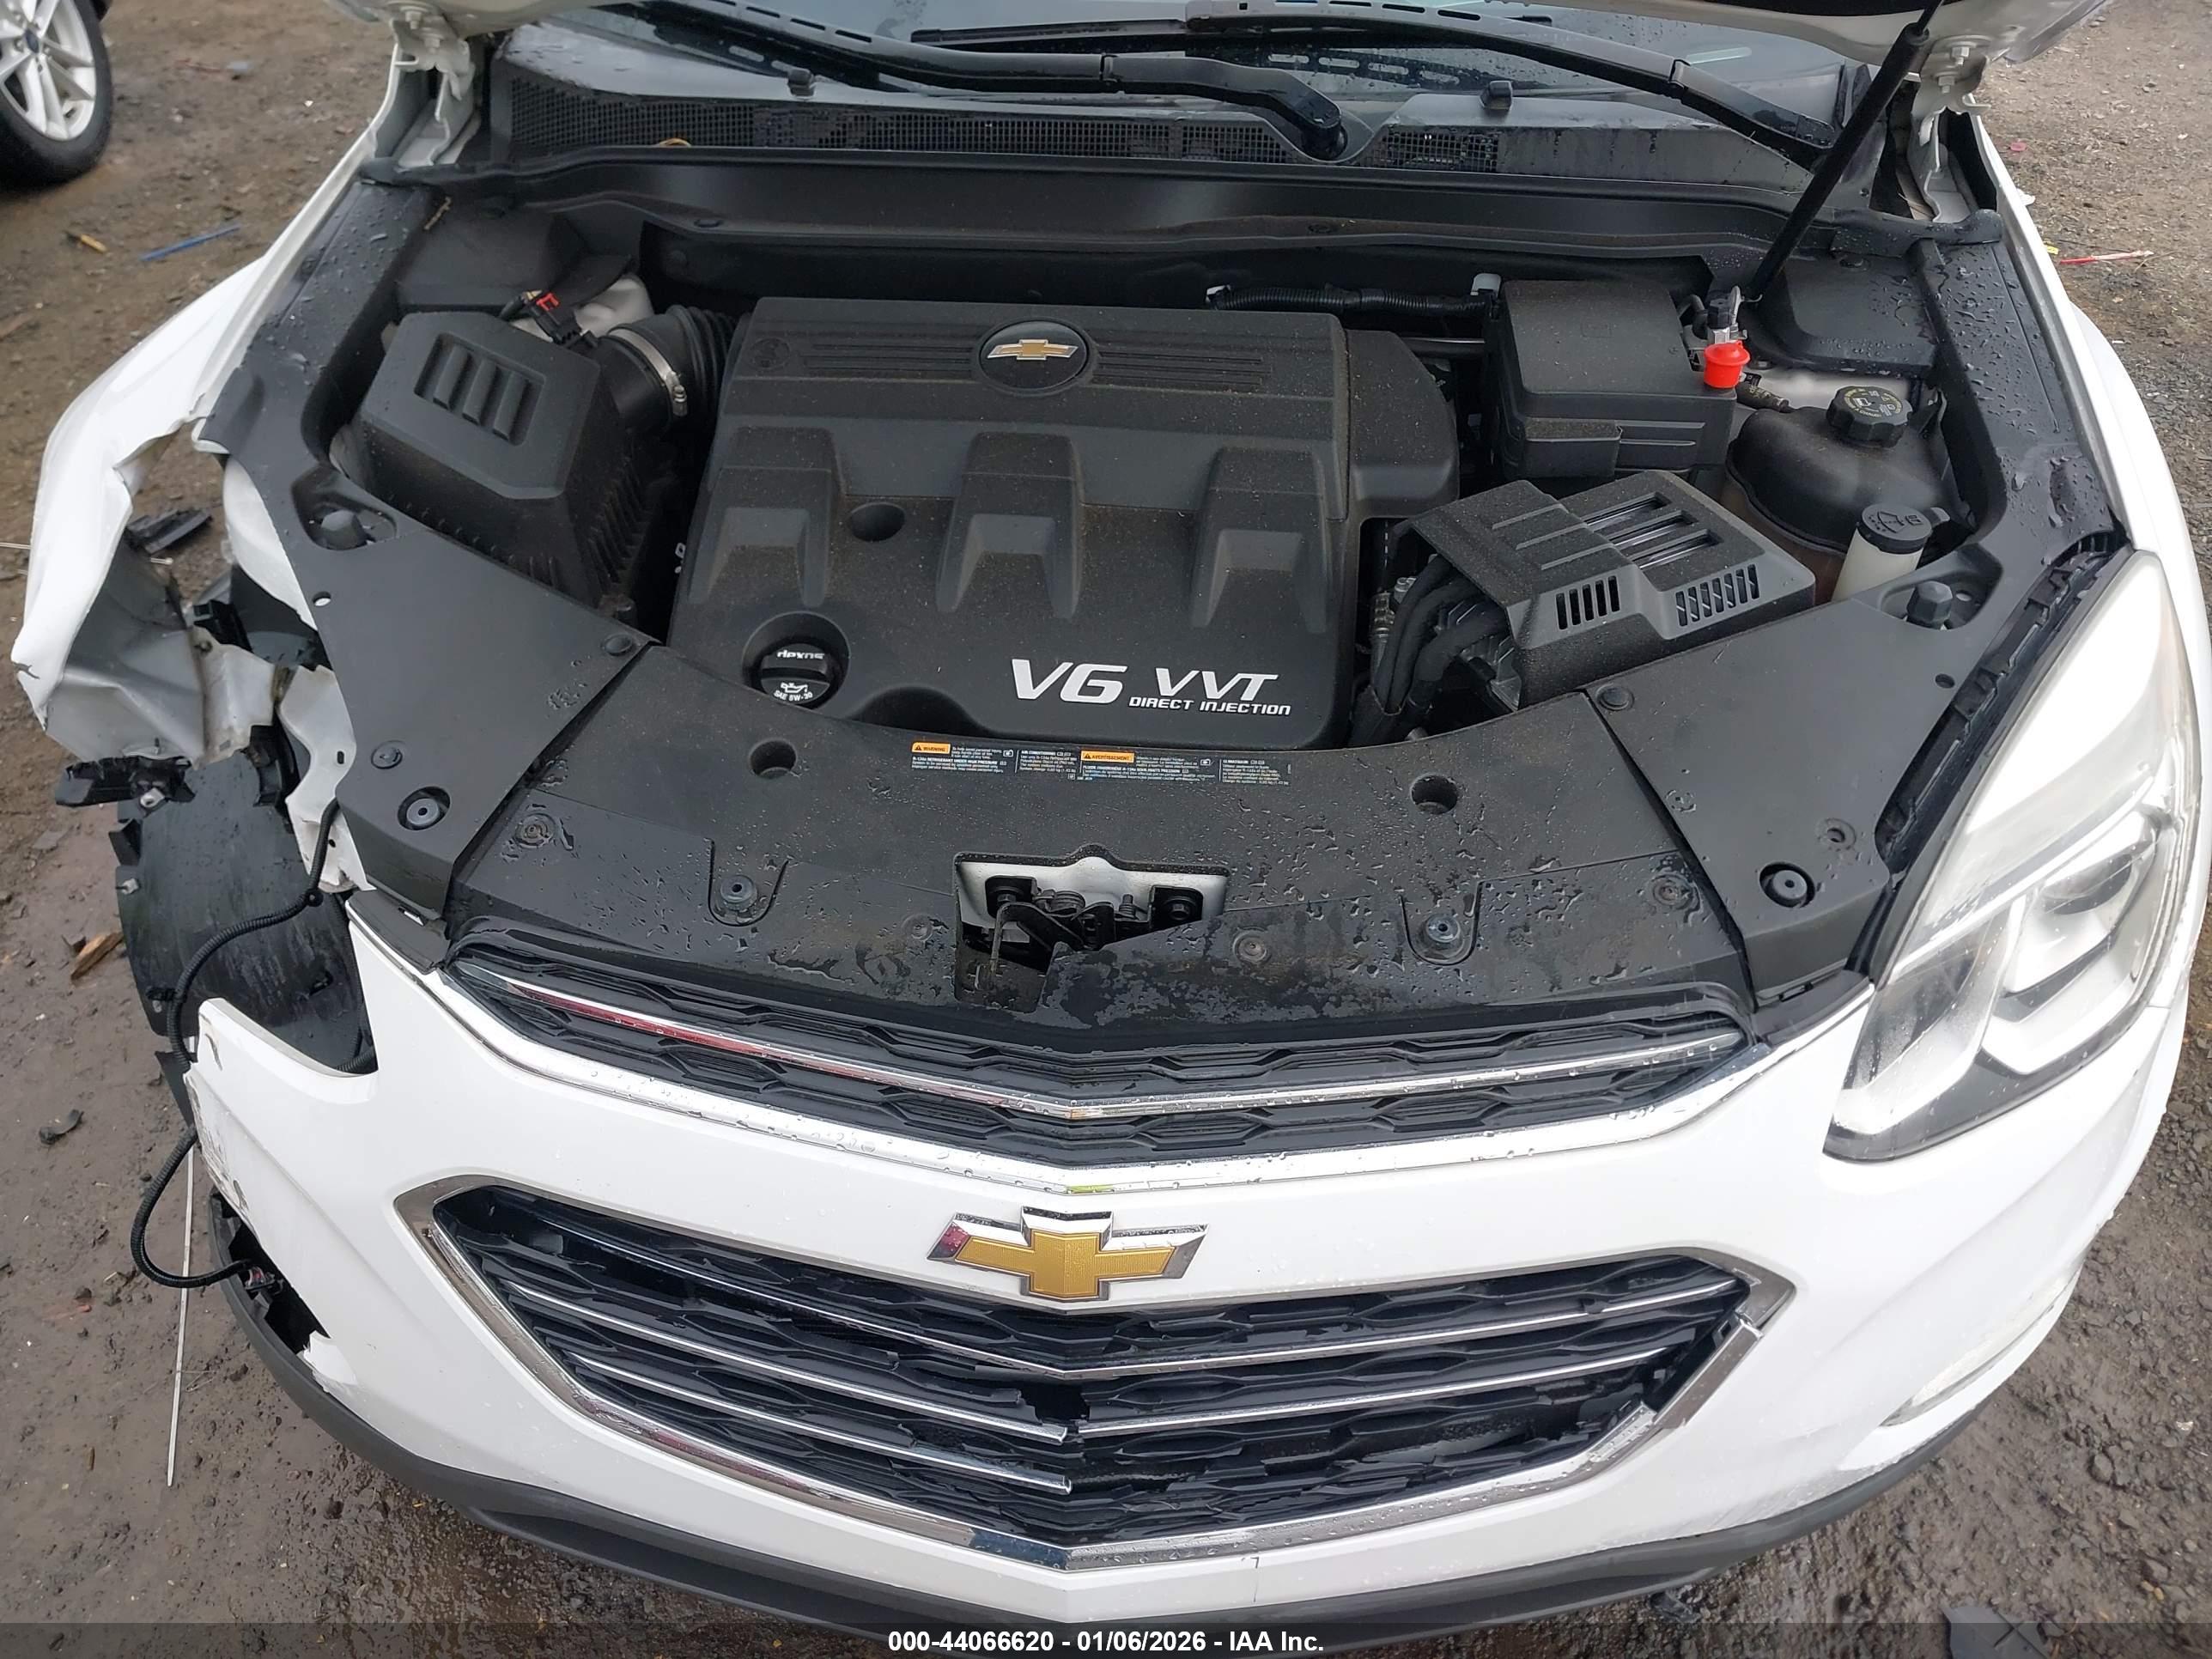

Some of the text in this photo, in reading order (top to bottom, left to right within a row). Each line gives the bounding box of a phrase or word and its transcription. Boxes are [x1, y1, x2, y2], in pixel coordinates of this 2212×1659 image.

[1012, 658, 1279, 705] V6 VVT
[1127, 696, 1291, 716] DIRECT INJECTION
